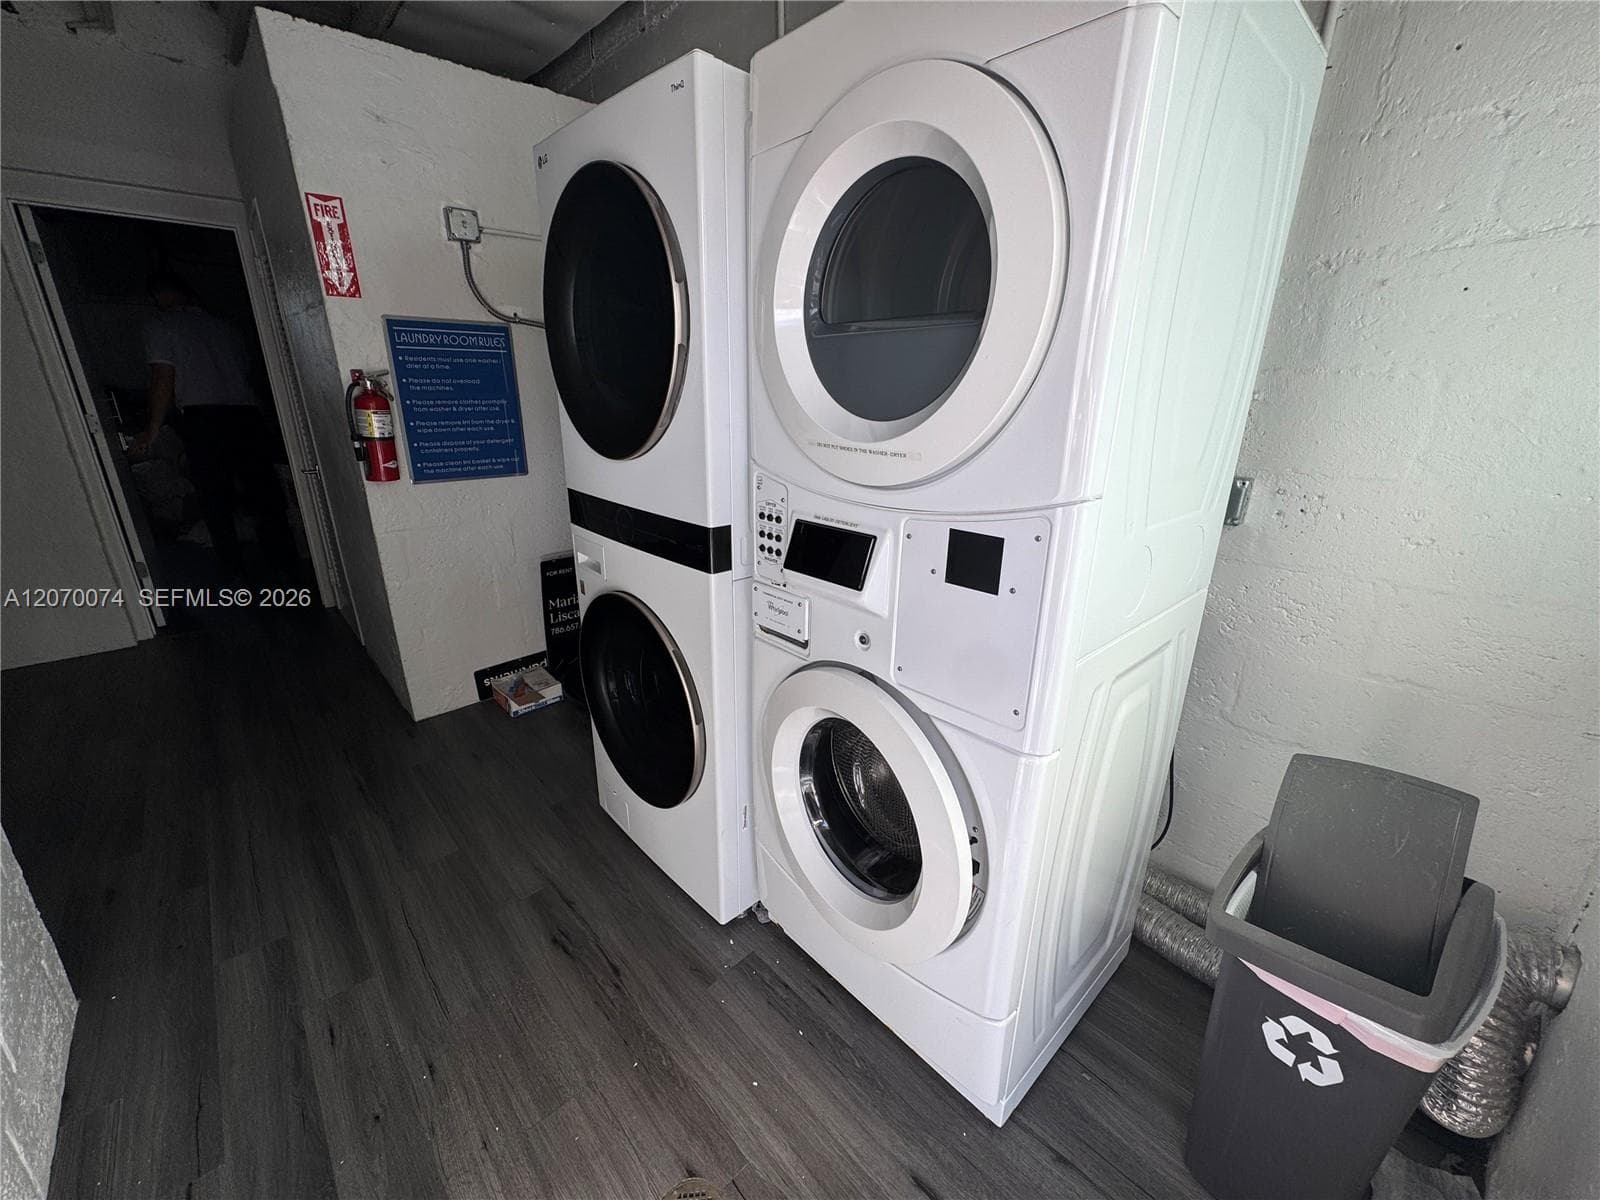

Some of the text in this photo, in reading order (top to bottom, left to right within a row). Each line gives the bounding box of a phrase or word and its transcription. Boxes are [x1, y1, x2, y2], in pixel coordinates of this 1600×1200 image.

[670, 79, 685, 93] ThinQ
[313, 203, 340, 219] FIRE
[394, 331, 506, 348] LAUNDRY ROOM RULES
[546, 567, 573, 577] FOR RENT
